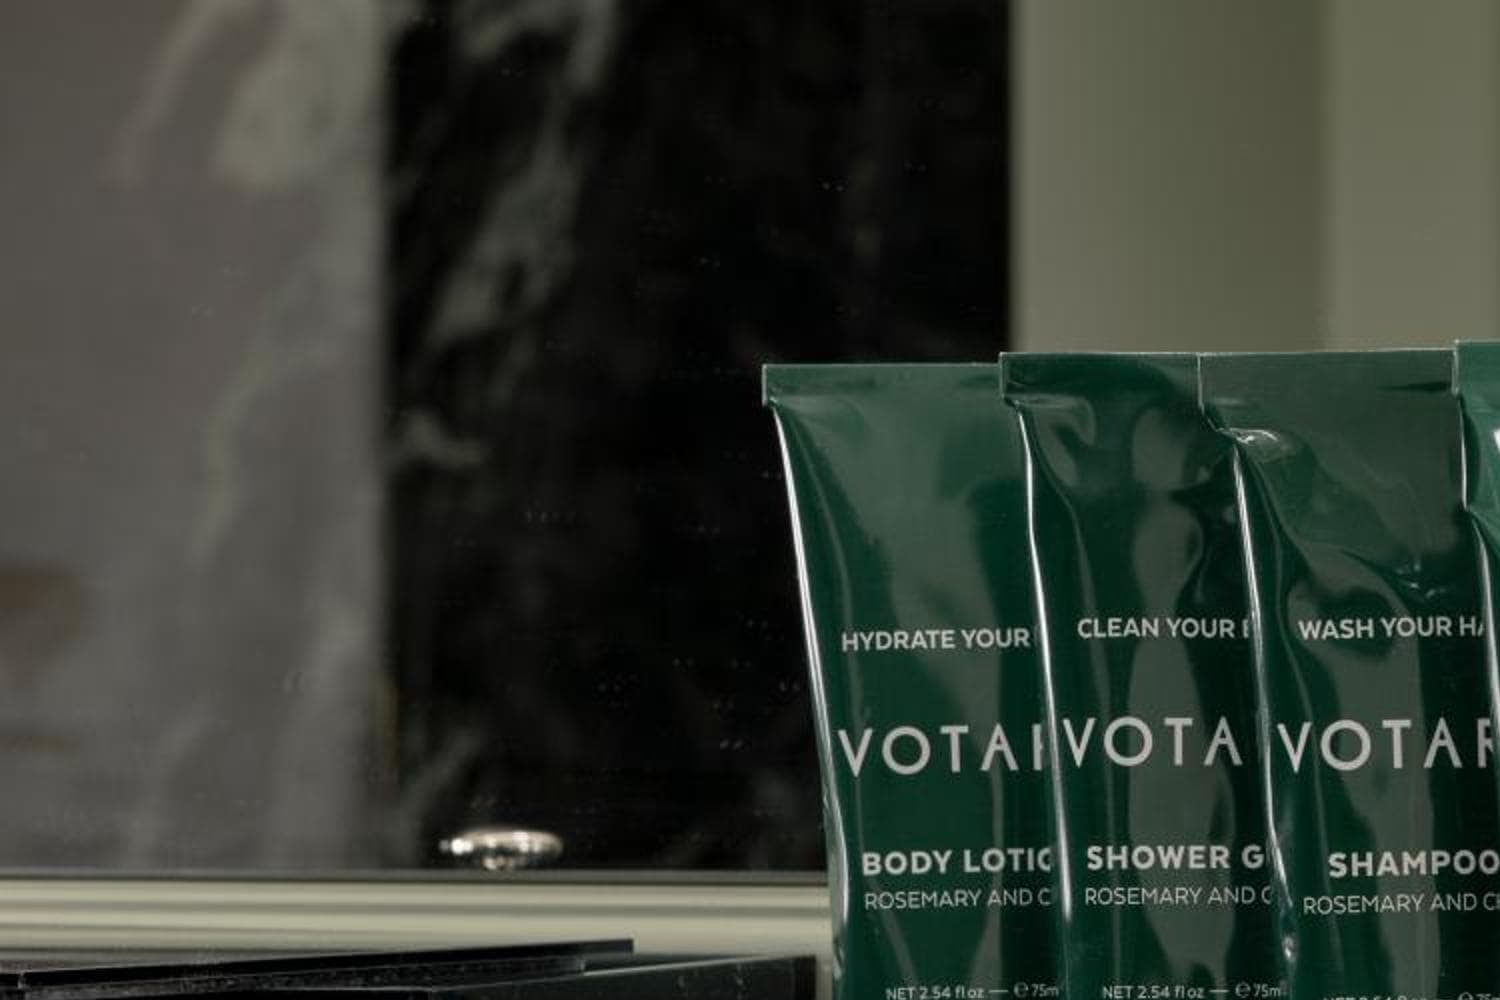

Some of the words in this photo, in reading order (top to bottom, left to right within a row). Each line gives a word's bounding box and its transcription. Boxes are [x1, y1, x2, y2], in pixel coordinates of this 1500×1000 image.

[1077, 617, 1159, 639] CLEAN
[1166, 617, 1235, 638] YOUR
[1298, 617, 1374, 641] WASH
[1380, 616, 1453, 638] YOUR
[841, 629, 956, 652] HYDRATE
[961, 628, 1030, 648] YOUR
[1062, 715, 1243, 768] VOTA
[862, 850, 953, 876] BODY
[1087, 845, 1230, 870] SHOWER
[1328, 849, 1500, 878] SHAMPOO
[864, 889, 982, 910] ROSEMARY
[987, 888, 1033, 907] AND
[1085, 886, 1203, 906] ROSEMARY
[1208, 886, 1256, 905] AND
[1303, 893, 1425, 915] ROSEMARY
[1430, 893, 1477, 912] AND
[885, 987, 915, 1000] NET
[919, 985, 951, 1000] 2.54
[967, 988, 984, 999] oz
[1103, 985, 1133, 999] NET
[1137, 985, 1170, 999] 2.54
[1187, 988, 1205, 999] oz
